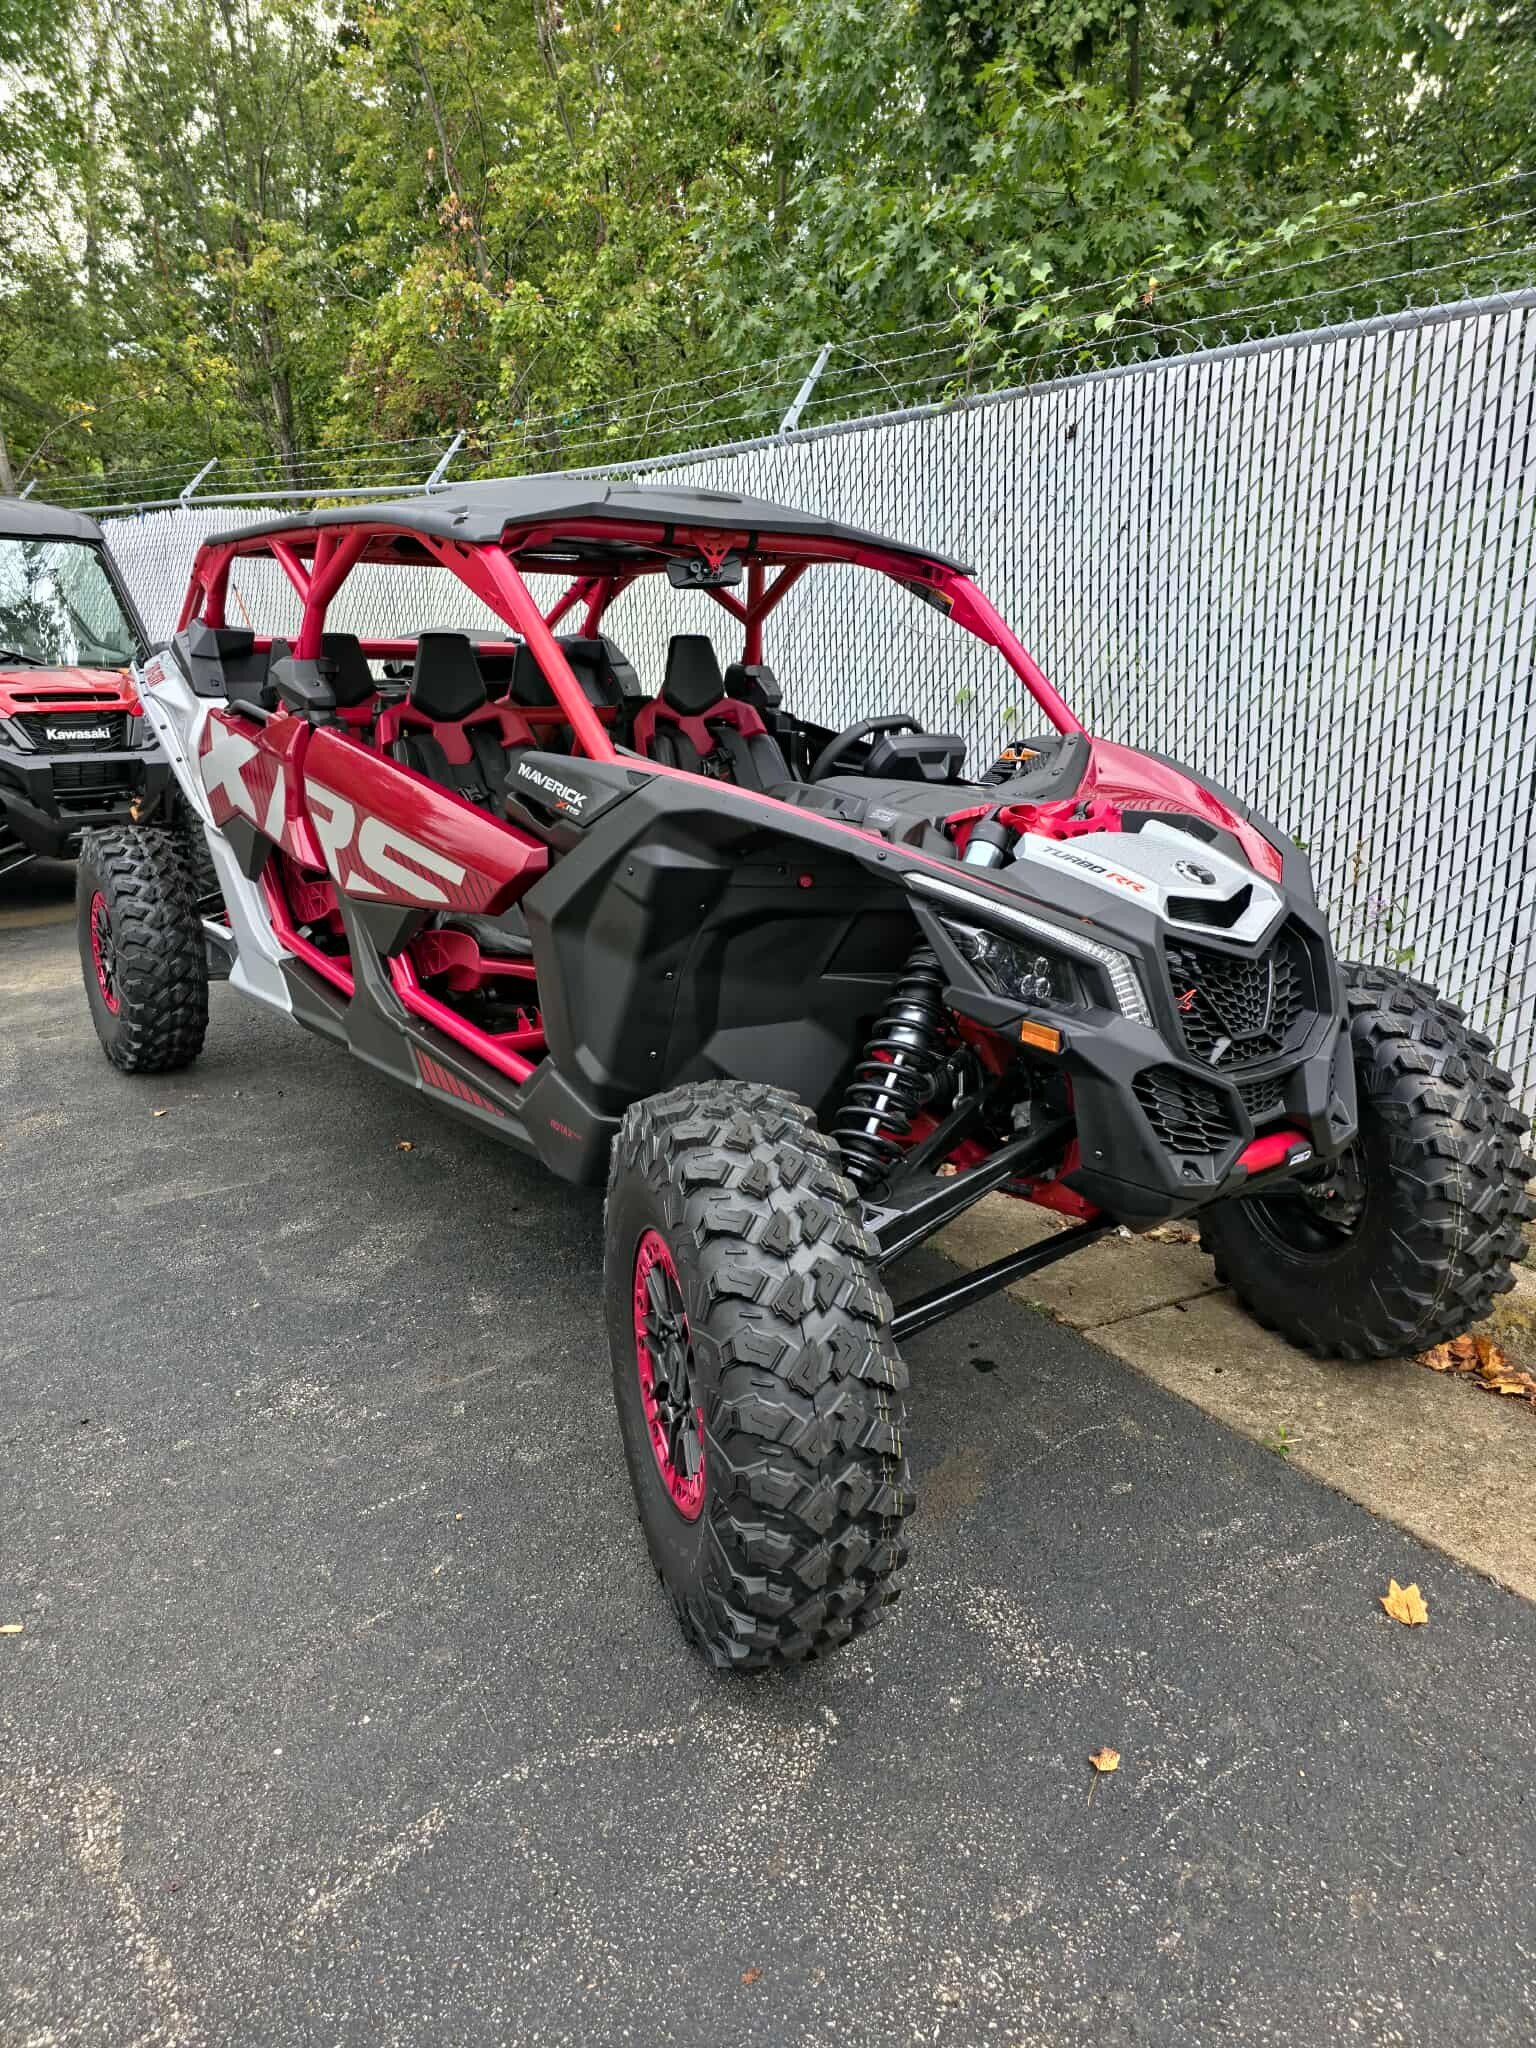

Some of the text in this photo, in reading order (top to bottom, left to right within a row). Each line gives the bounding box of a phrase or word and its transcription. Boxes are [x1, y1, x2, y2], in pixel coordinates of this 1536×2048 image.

[46, 727, 111, 741] Kawasaki
[517, 761, 588, 808] MAVERICK
[200, 715, 467, 904] XRS
[1043, 845, 1146, 894] TURBO RR
